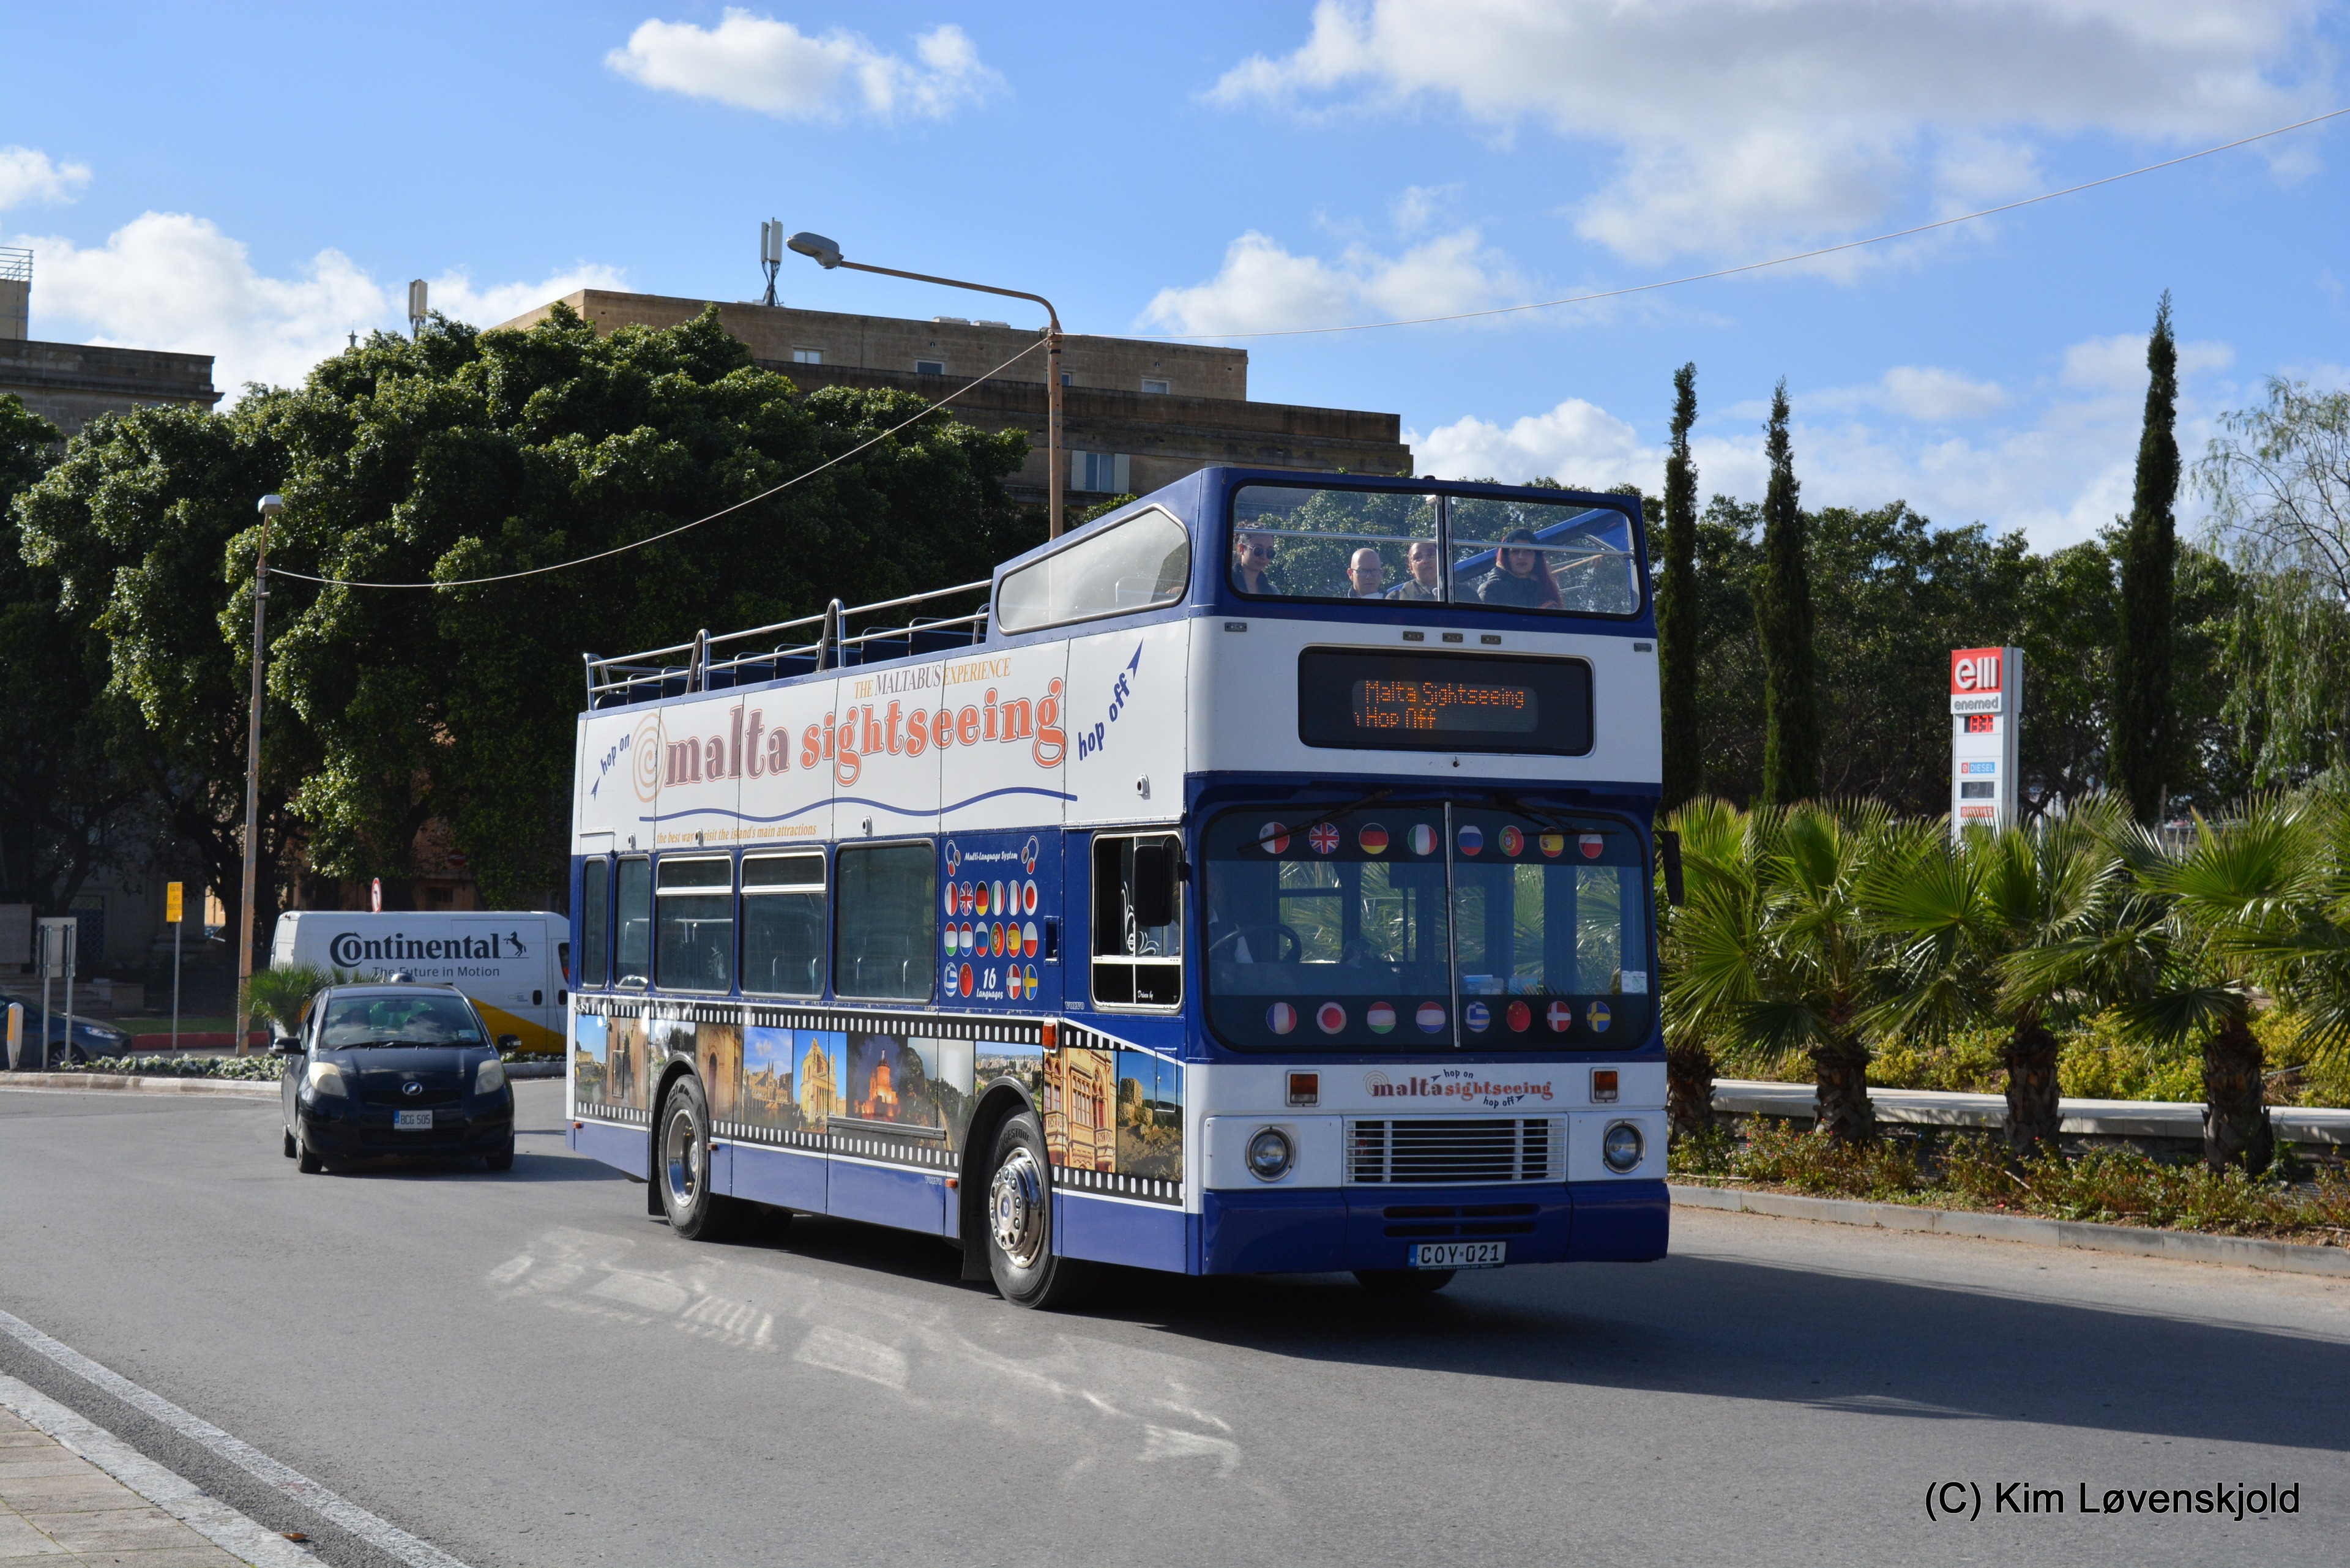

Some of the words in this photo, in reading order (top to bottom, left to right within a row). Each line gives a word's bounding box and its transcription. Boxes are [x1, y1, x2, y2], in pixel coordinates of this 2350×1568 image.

[854, 679, 874, 700] THE
[875, 664, 941, 696] MALTABUS
[943, 657, 1011, 686] EXPERIENCE
[1365, 680, 1417, 704] Malta
[1423, 682, 1524, 709] Sightseeing
[1954, 696, 1999, 711] enemed
[1078, 722, 1105, 761] hop
[1109, 672, 1130, 723] off
[1366, 706, 1400, 728] Hop
[665, 704, 791, 788] malta
[800, 676, 1069, 788] sightseeing
[600, 746, 617, 776] hop
[619, 733, 630, 752] on
[1970, 763, 1994, 772] DIESEL
[657, 832, 667, 844] the
[668, 832, 681, 843] best
[682, 832, 695, 845] way
[703, 829, 717, 842] visit
[718, 829, 729, 840] the
[757, 824, 776, 838] main
[777, 823, 817, 837] attractions
[964, 851, 1001, 862] Multi-Language
[1001, 850, 1018, 862] System
[329, 931, 502, 968] Continental
[372, 966, 395, 977] The
[442, 966, 453, 977] in
[457, 966, 500, 977] Motion
[983, 968, 996, 990] 16
[976, 987, 1004, 1001] Languages
[1064, 1001, 1085, 1010] VOLVO
[1443, 1069, 1460, 1079] hop
[1483, 1096, 1499, 1109] hop
[1502, 1096, 1515, 1107] off
[400, 1114, 414, 1125] BCG
[417, 1114, 431, 1125] 505
[924, 1175, 942, 1185] VOLVO
